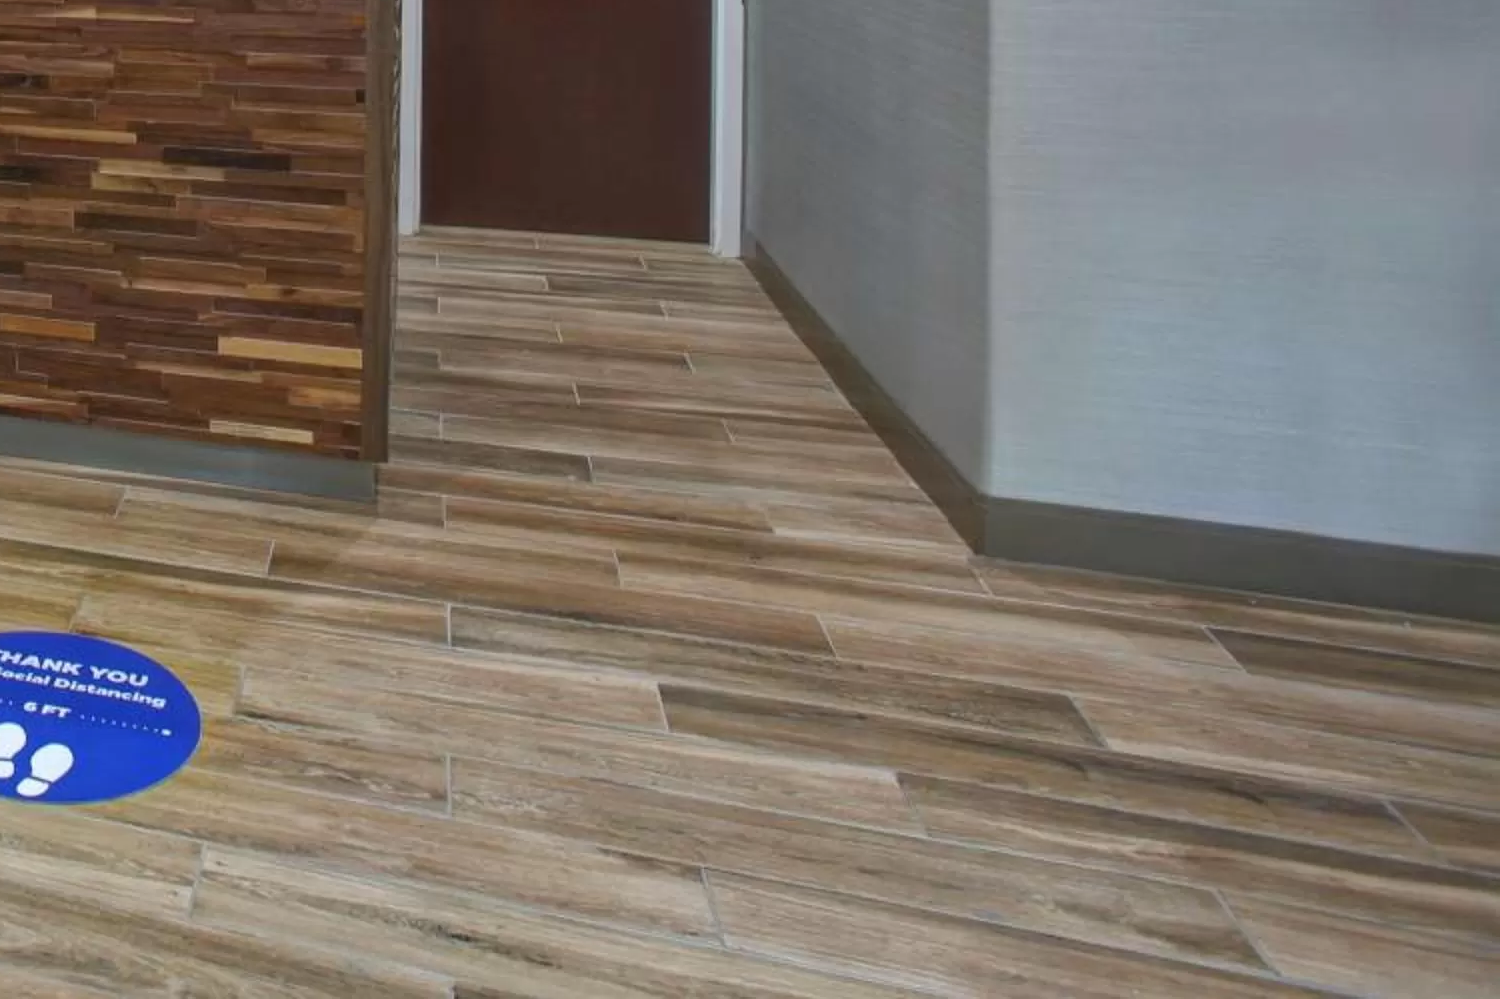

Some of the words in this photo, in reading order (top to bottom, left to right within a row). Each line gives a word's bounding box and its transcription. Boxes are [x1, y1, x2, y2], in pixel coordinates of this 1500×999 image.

[88, 665, 150, 687] YOU
[53, 677, 167, 710] Distancing
[23, 701, 38, 713] 6
[41, 705, 73, 719] FT
